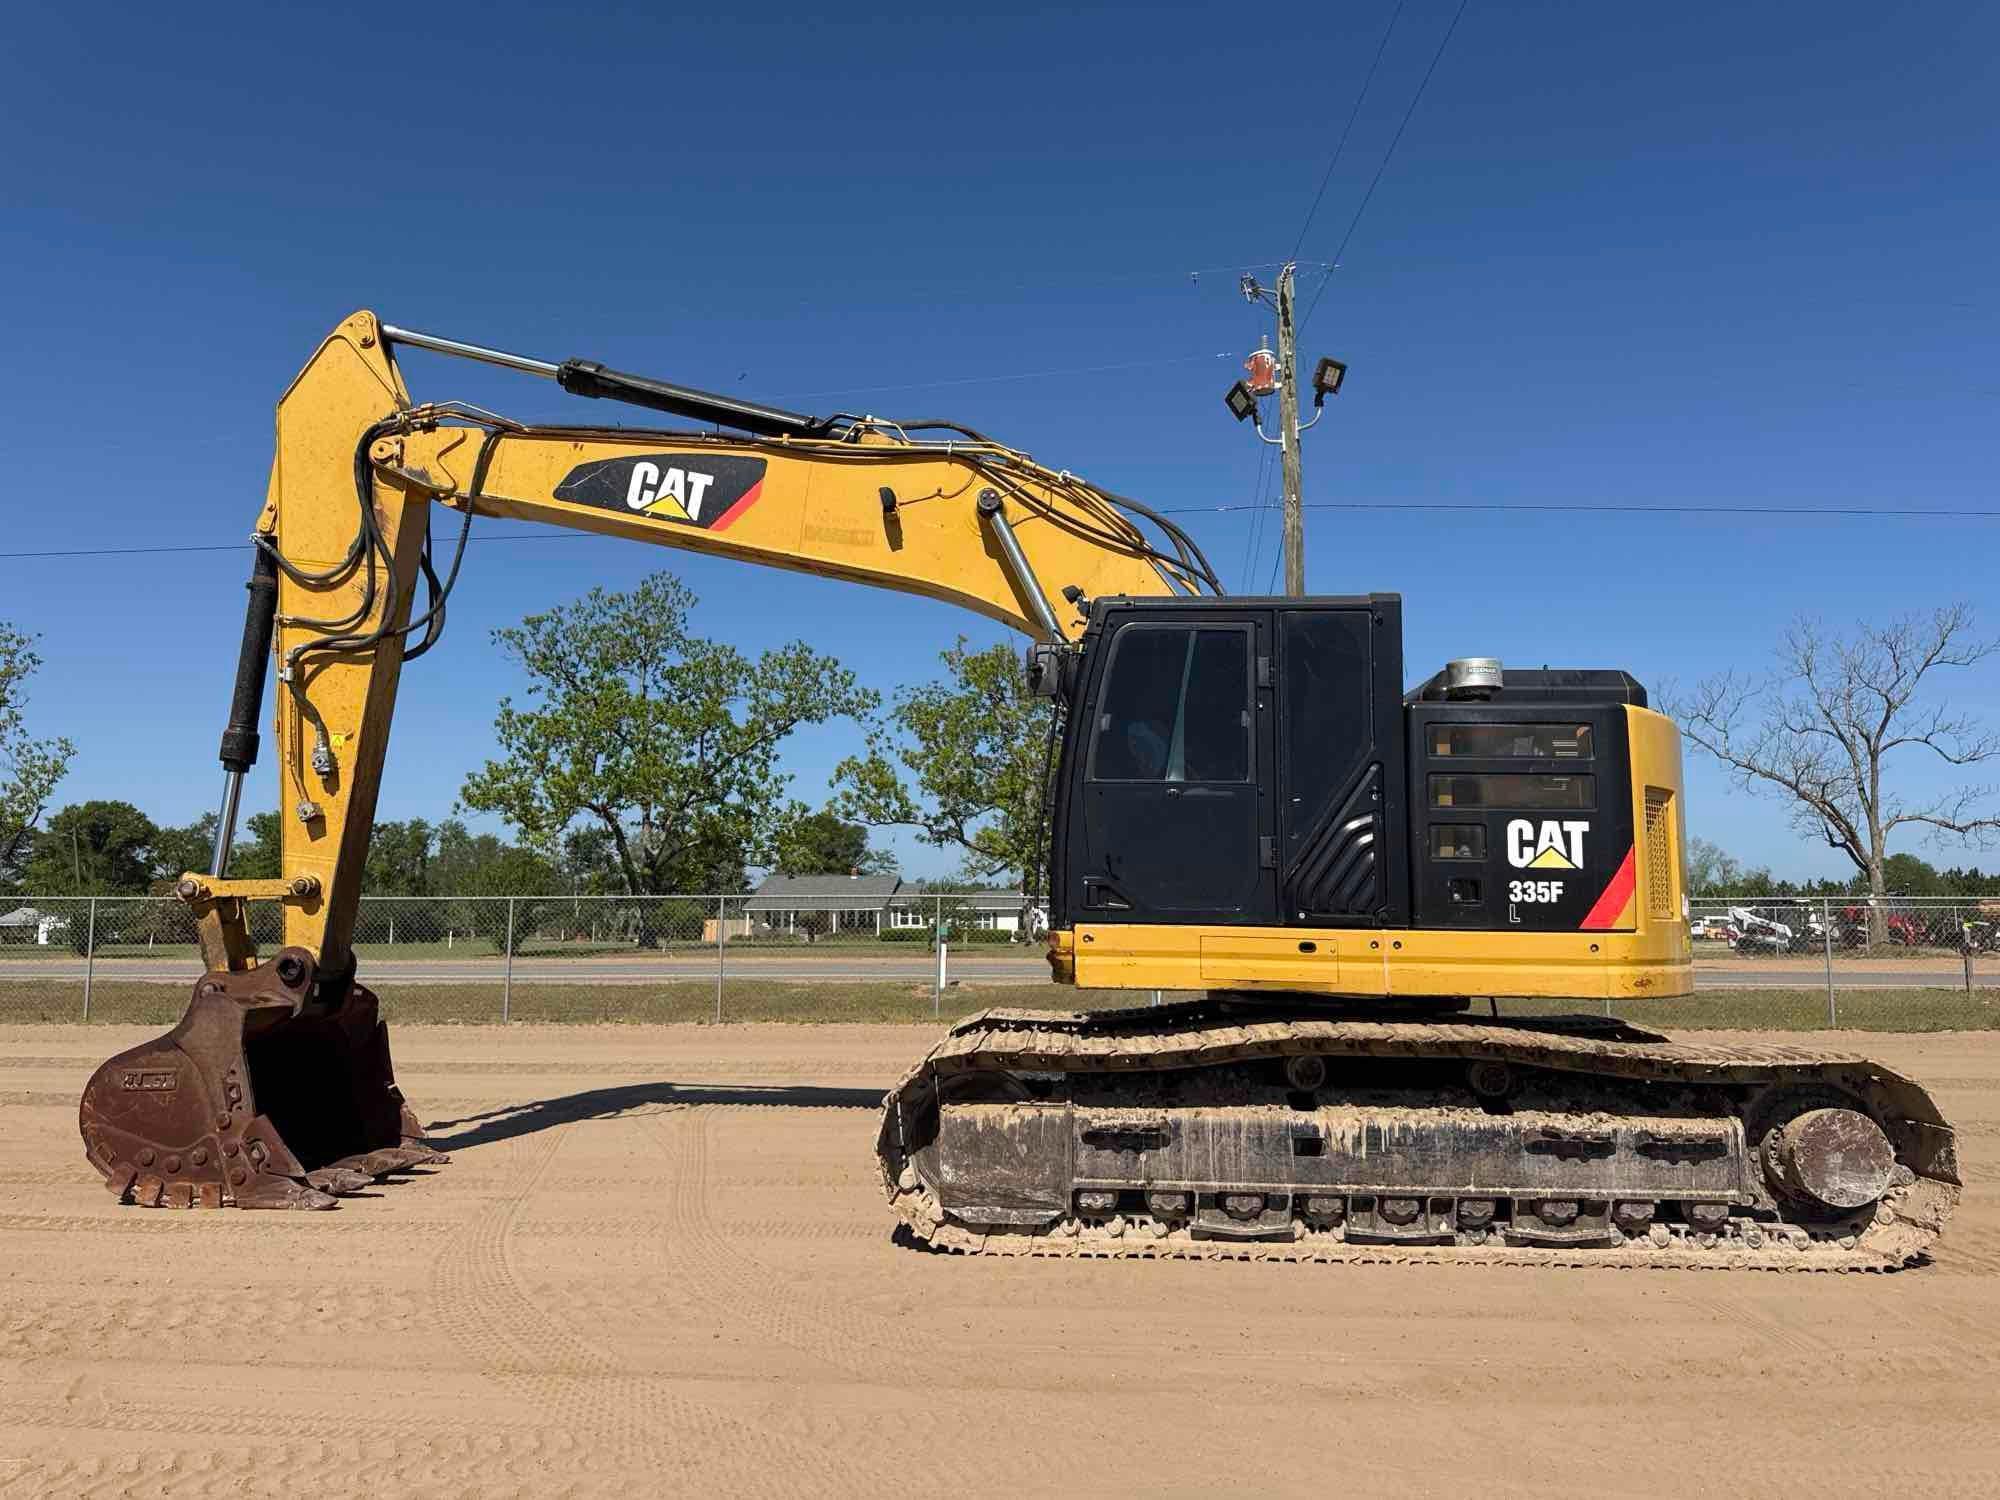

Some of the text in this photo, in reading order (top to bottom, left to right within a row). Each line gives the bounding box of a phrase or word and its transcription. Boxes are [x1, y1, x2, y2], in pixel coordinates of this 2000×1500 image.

[627, 462, 714, 521] CAT
[1507, 819, 1590, 869] CAT
[1509, 881, 1564, 903] 335F
[1509, 903, 1521, 923] L
